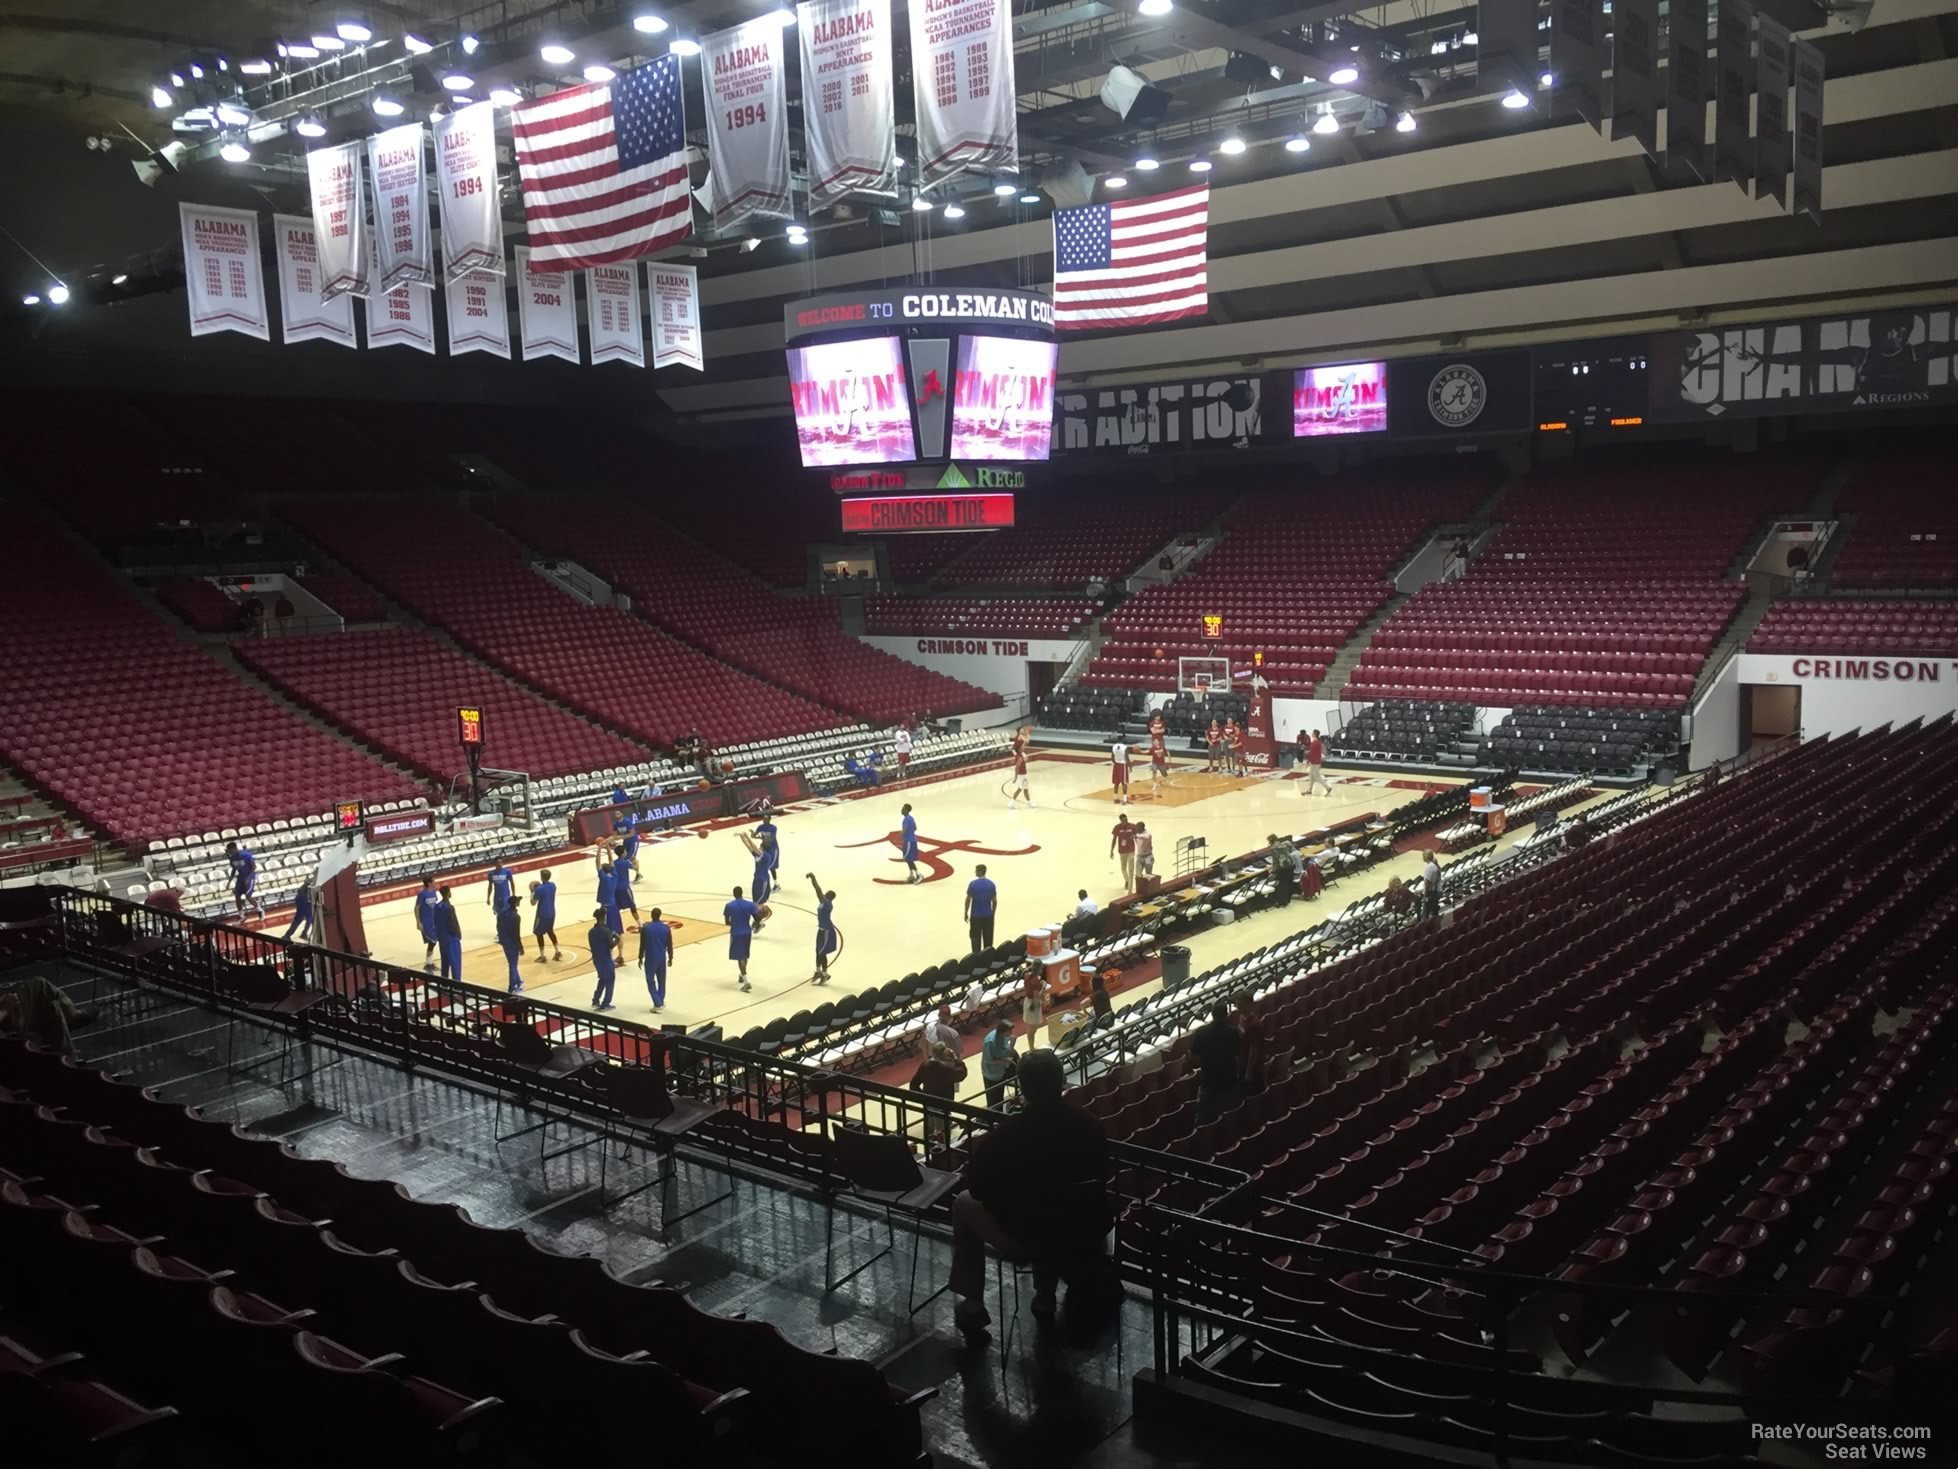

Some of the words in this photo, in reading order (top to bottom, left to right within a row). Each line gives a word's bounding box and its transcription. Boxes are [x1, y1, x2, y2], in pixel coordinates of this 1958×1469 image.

[813, 10, 874, 45] ALABAMA
[945, 8, 995, 29] TOURNAMENT
[929, 18, 991, 45] APPEARANCES
[715, 43, 769, 76] ALABAMA
[818, 51, 873, 74] APPEARANCES
[724, 89, 745, 102] FINAL
[746, 83, 764, 96] FOUR
[726, 102, 766, 130] 1994
[378, 147, 416, 169] ALABAMA
[453, 176, 483, 198] 1994
[194, 219, 247, 237] ALABAMA
[594, 268, 630, 281] ALABAMA
[656, 274, 689, 288] ALABAMA
[466, 296, 486, 306] 1991
[533, 293, 561, 306] 2004
[466, 307, 488, 317] 2004
[797, 304, 865, 326] WELCOME
[870, 303, 893, 318] TO
[902, 295, 1026, 320] COLEMAN
[1435, 371, 1480, 394] ALABAMA
[1868, 391, 1930, 405] REGIONS
[871, 501, 948, 527] CRIMSON
[952, 499, 985, 524] TIDE
[1206, 624, 1219, 636] 30
[917, 639, 988, 656] CRIMSON
[992, 641, 1029, 656] TIDE
[1793, 659, 1940, 682] CRIMSON
[463, 722, 478, 742] 30
[632, 803, 690, 824] AABAMA
[1059, 964, 1071, 984] G
